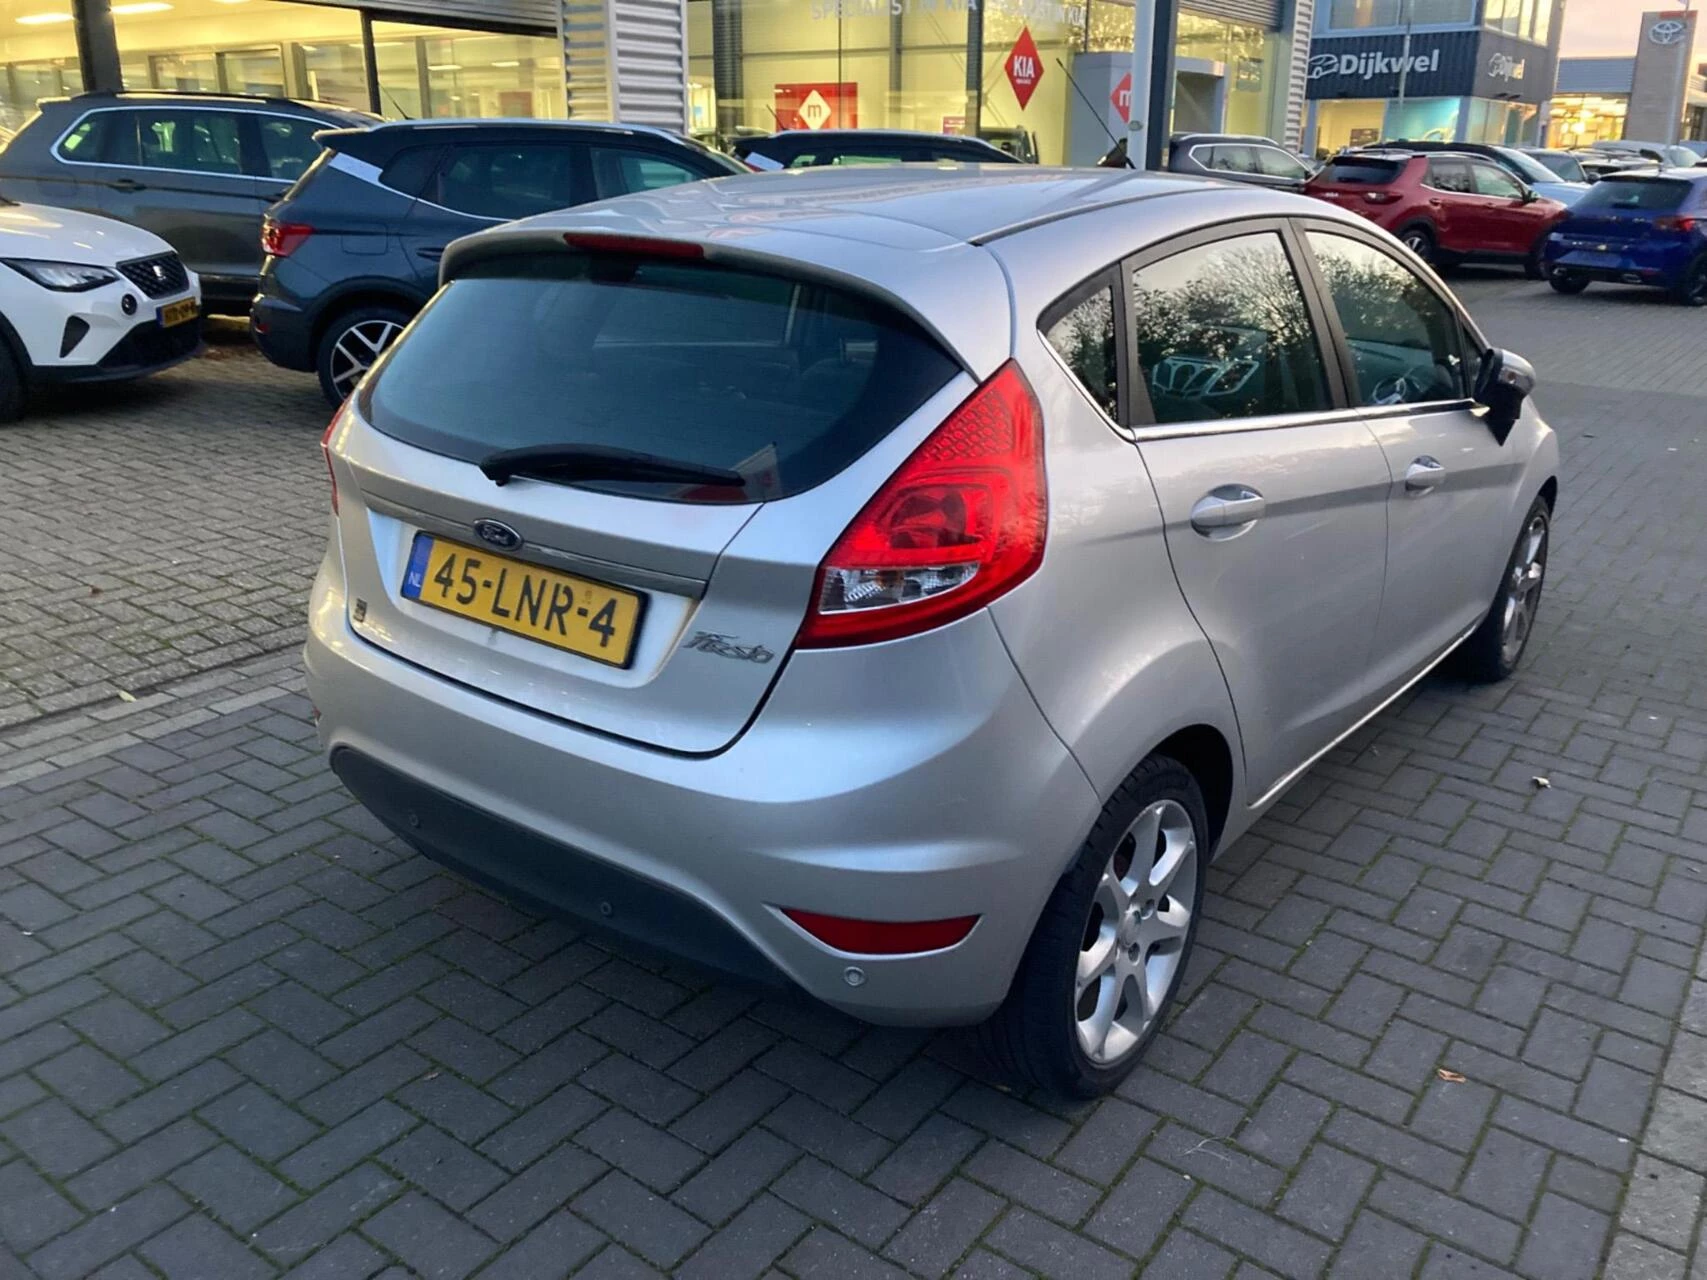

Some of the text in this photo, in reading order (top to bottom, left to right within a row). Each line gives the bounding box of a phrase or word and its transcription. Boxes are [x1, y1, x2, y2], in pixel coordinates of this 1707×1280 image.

[1013, 54, 1035, 78] KIA
[1340, 49, 1440, 80] Dijkwel
[807, 104, 822, 119] m
[408, 571, 421, 588] NL
[434, 553, 617, 648] 45-LNR-4
